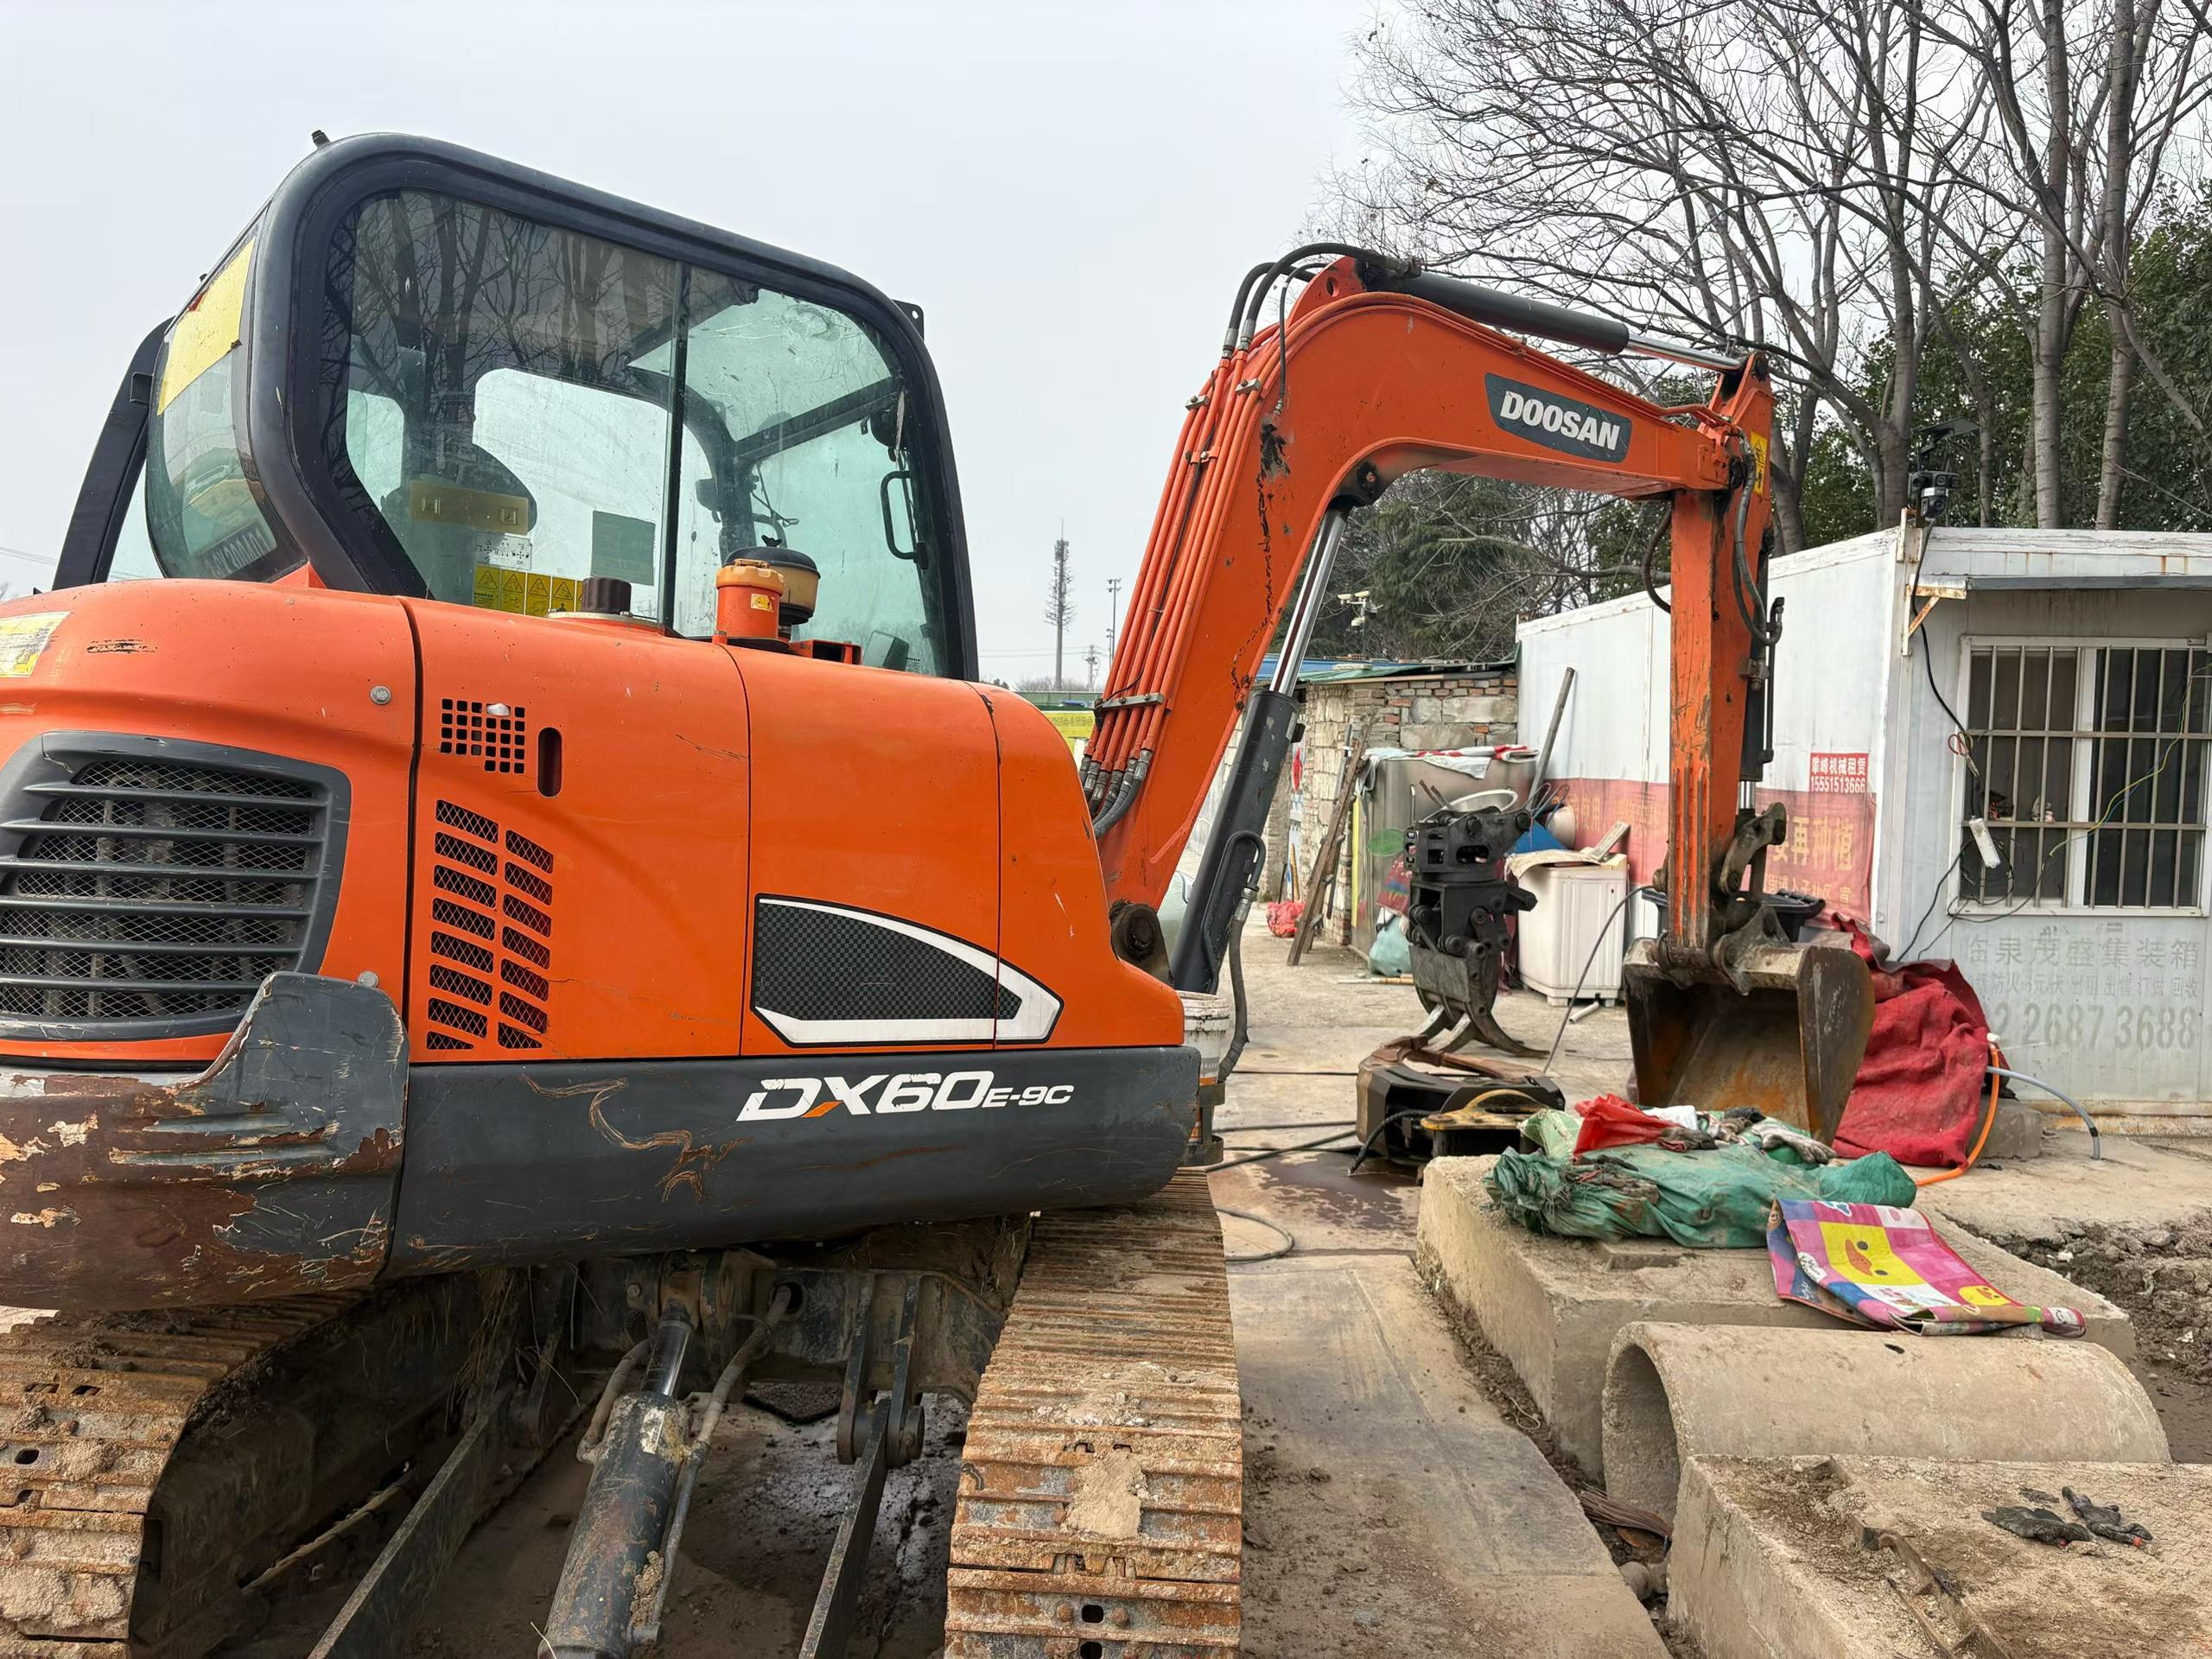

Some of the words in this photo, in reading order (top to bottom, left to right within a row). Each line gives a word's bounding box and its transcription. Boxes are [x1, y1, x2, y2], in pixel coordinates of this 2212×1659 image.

[1500, 391, 1620, 450] DOOSAN
[1810, 776, 1866, 793] 15551513666
[2023, 1002, 2103, 1050] 2687
[2114, 1005, 2196, 1051] 3688
